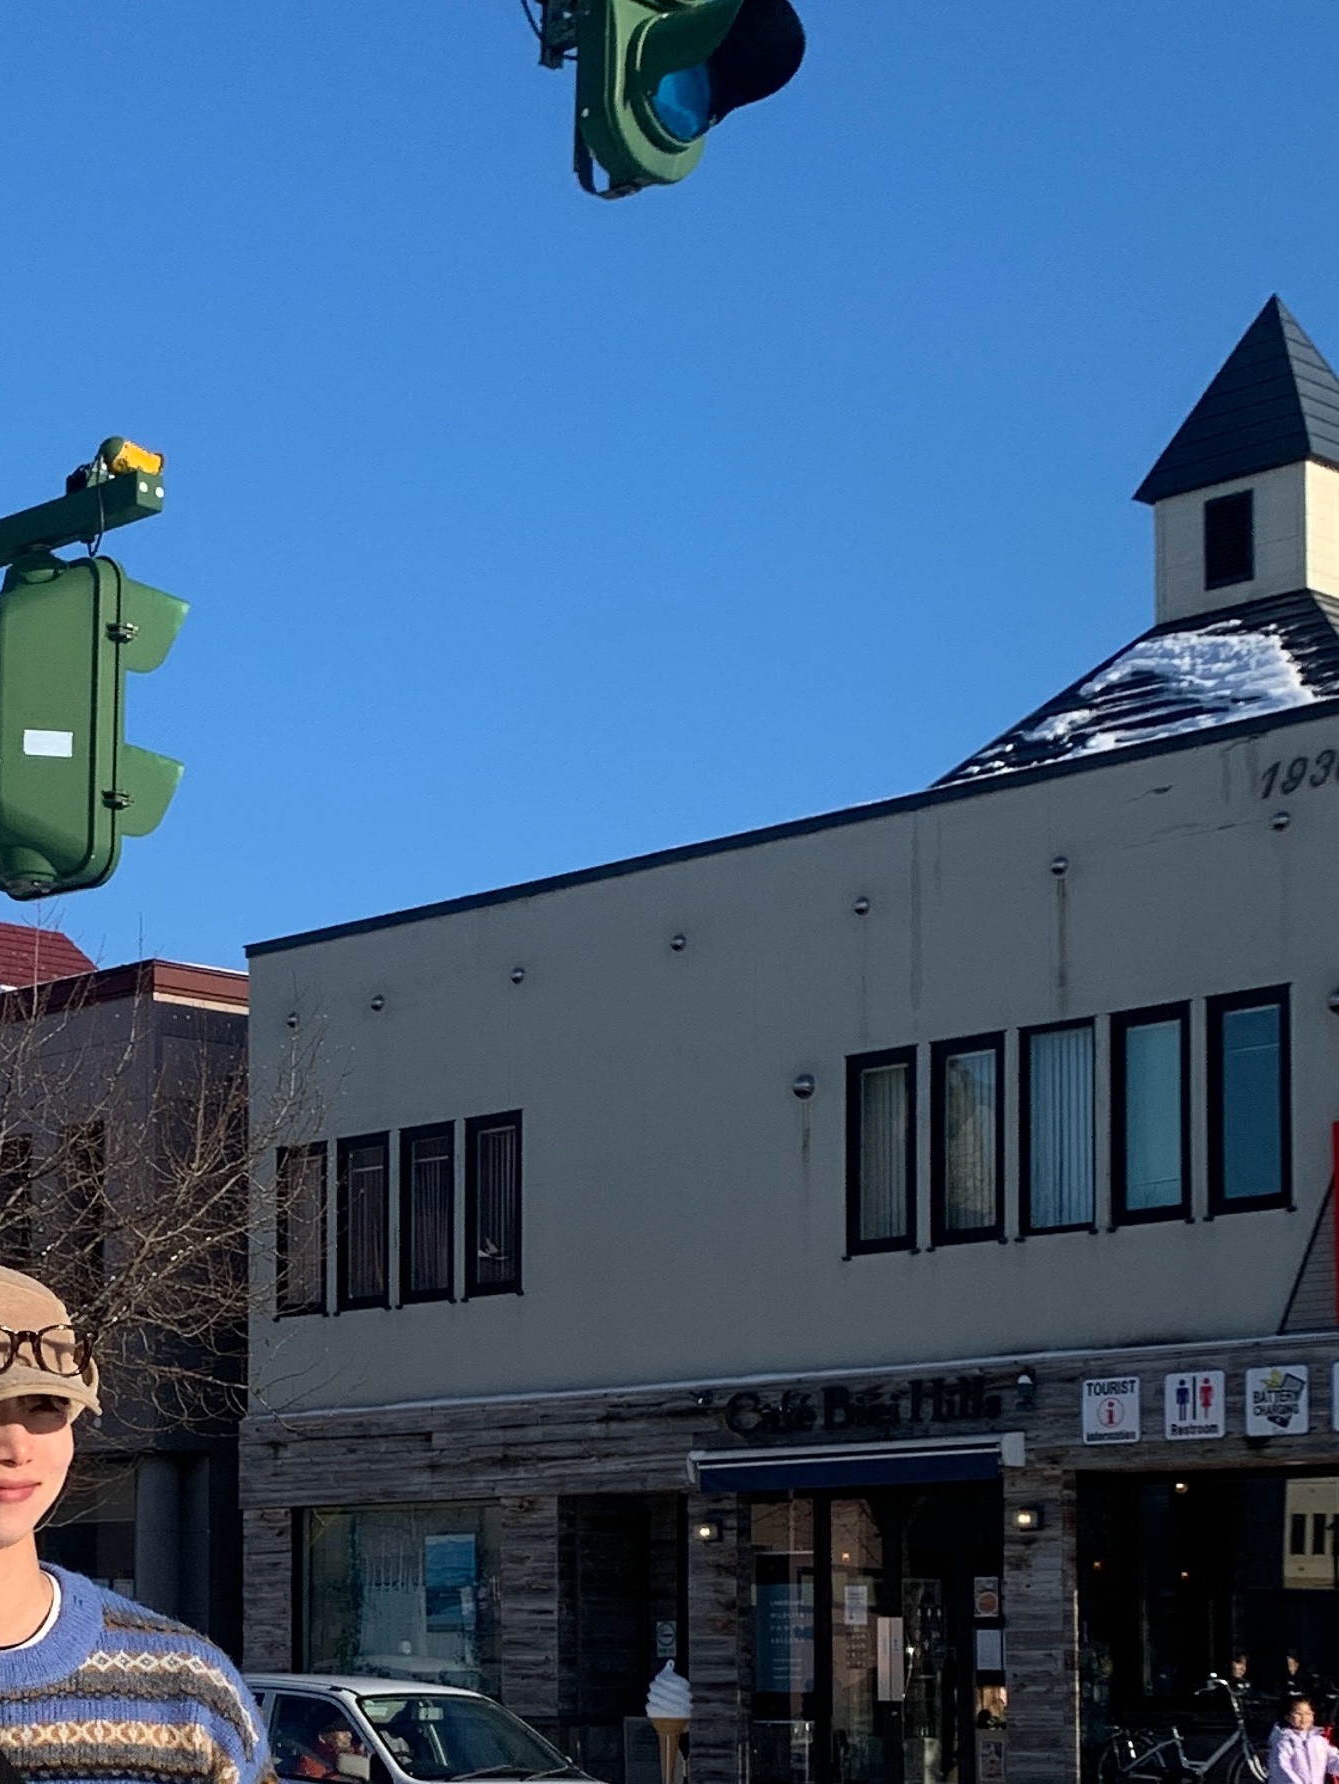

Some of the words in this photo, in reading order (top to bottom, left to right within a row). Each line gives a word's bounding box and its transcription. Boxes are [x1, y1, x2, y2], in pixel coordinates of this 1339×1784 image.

[1261, 749, 1339, 799] 193
[1086, 1379, 1136, 1397] TOURIST
[1253, 1389, 1299, 1404] BATTERY
[725, 1389, 818, 1436] Café
[1253, 1404, 1299, 1417] CHARGING
[1171, 1423, 1218, 1435] Restroom
